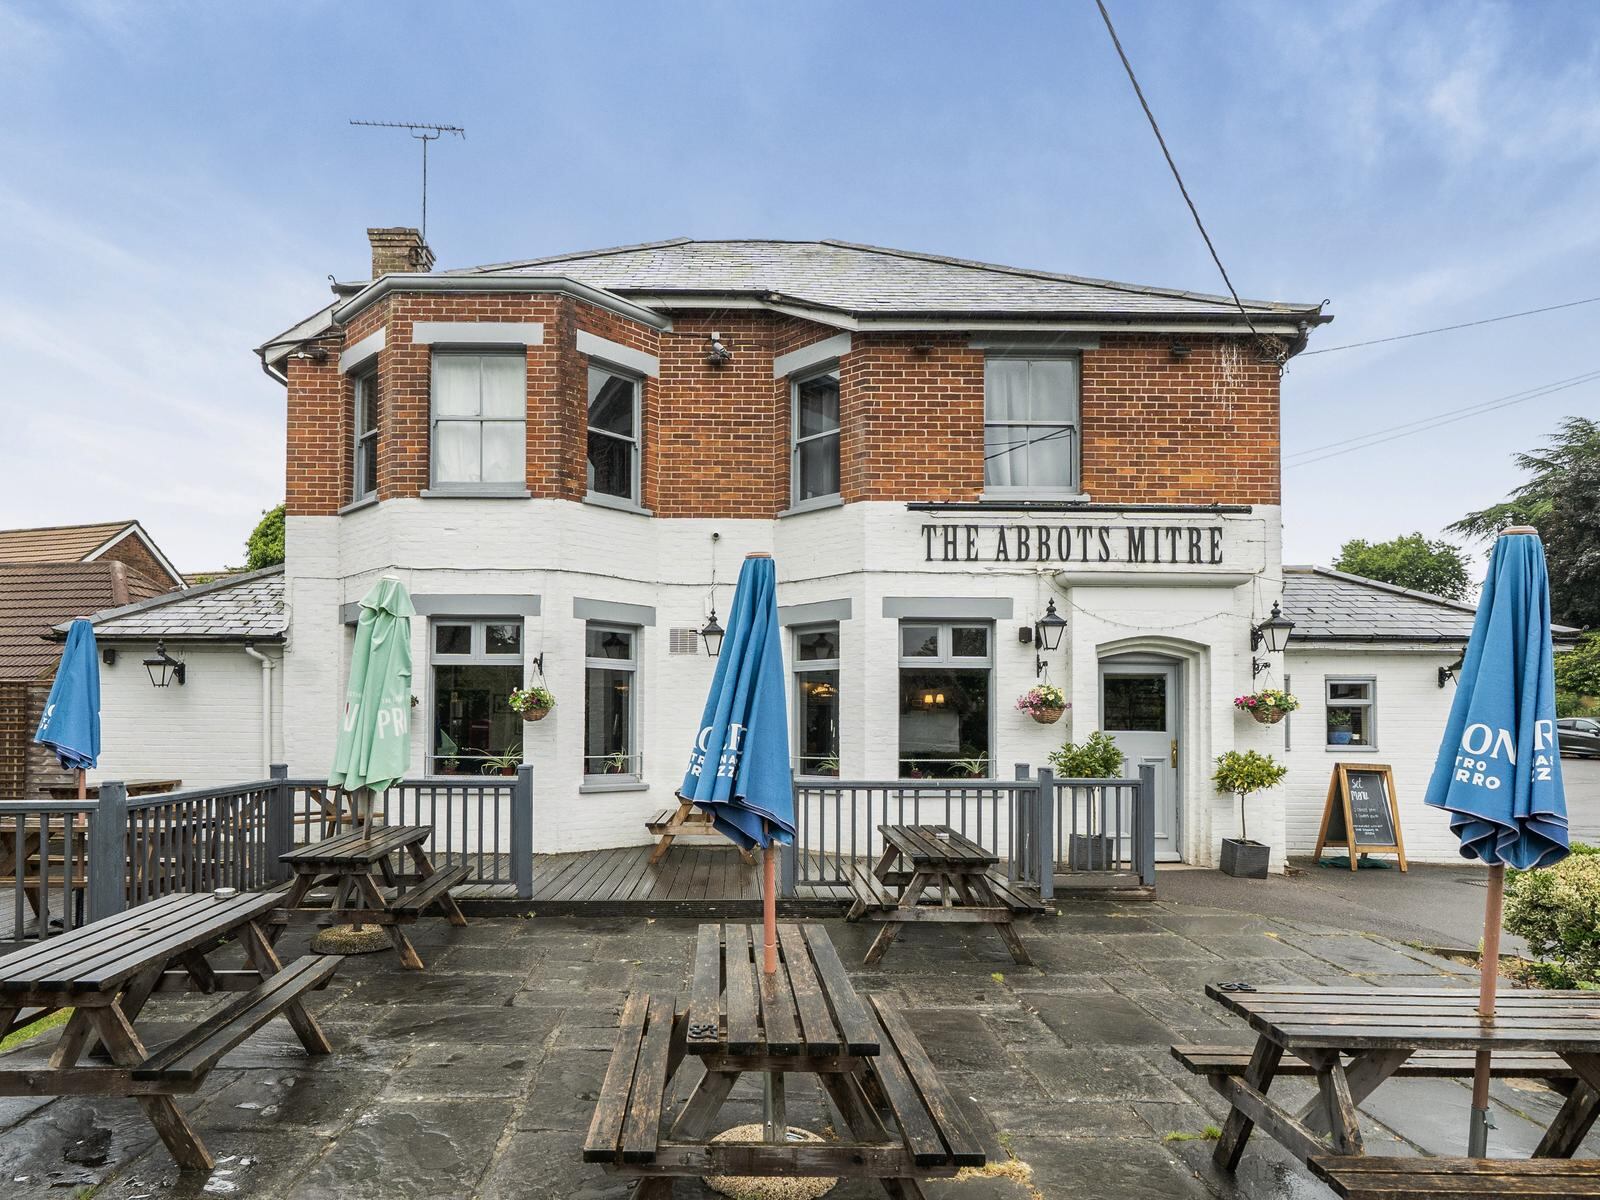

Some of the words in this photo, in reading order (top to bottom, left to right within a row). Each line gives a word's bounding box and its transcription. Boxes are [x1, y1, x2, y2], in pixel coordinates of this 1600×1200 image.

[922, 524, 979, 562] THE
[995, 524, 1111, 563] ABBOTS
[1127, 526, 1223, 564] MITRE
